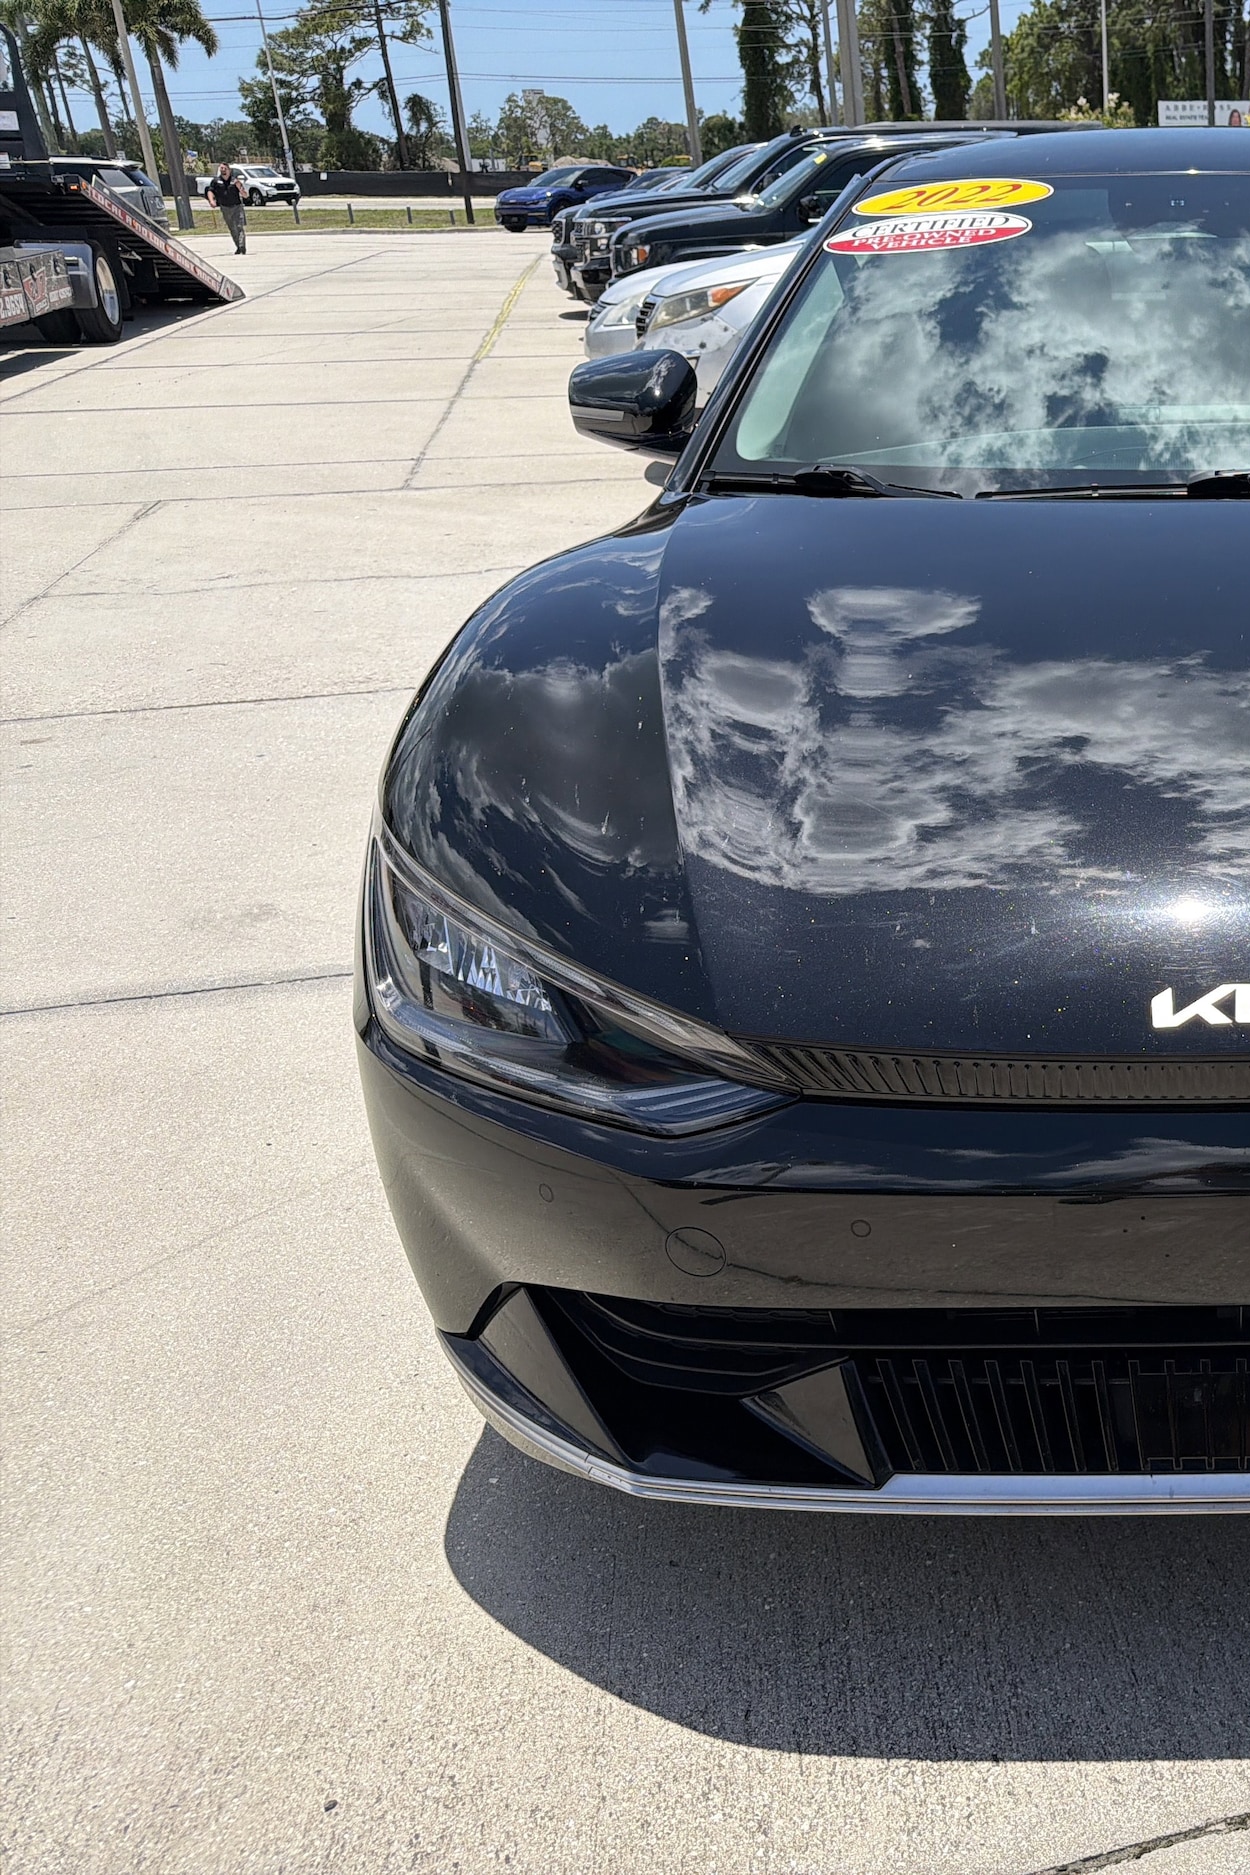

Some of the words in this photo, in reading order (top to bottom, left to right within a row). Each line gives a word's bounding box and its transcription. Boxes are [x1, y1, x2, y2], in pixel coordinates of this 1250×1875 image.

[91, 188, 125, 220] LOCAL
[880, 184, 1023, 211] 2022
[851, 216, 1010, 239] CERTIFIED
[852, 228, 997, 247] PRE-OWNED
[870, 236, 972, 251] VEHICLE
